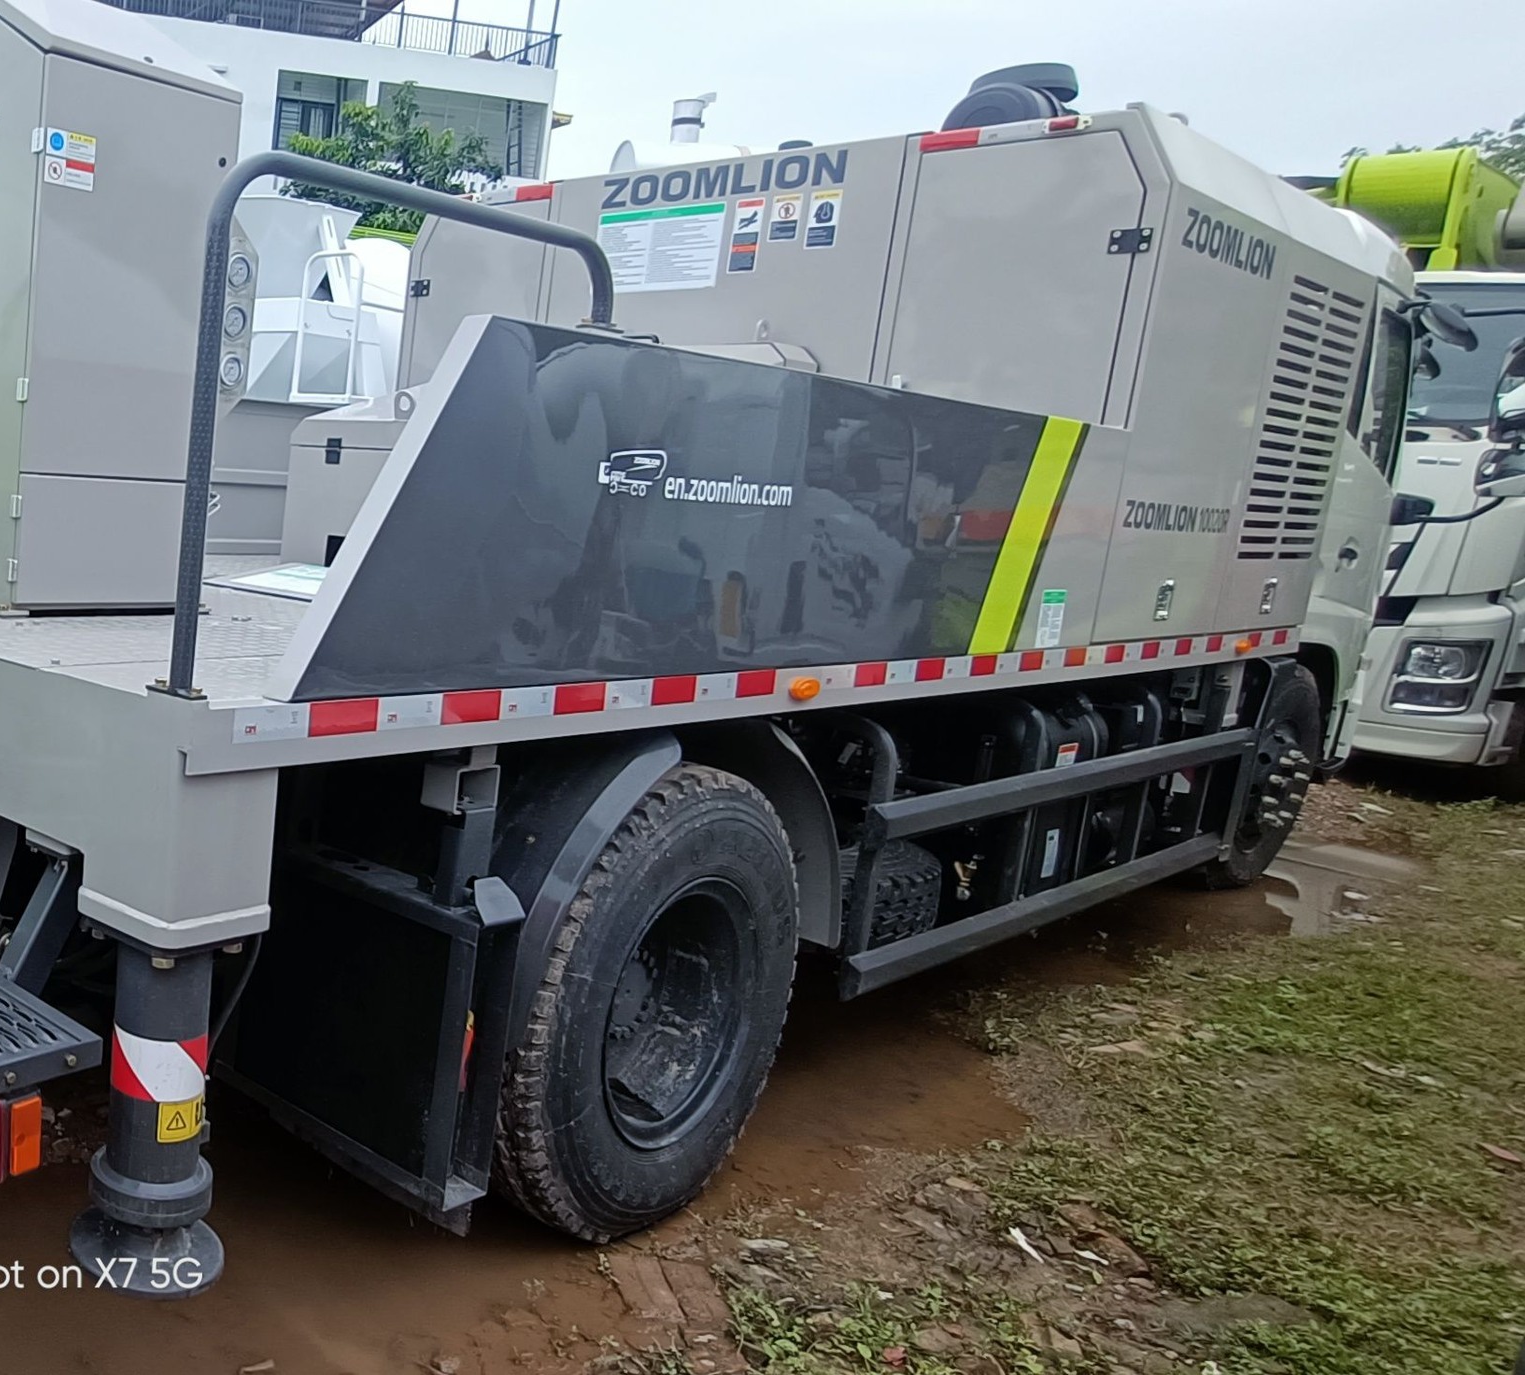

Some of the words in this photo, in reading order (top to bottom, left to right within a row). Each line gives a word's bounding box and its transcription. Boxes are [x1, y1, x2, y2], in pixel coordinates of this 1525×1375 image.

[601, 149, 848, 210] ZOOMLION
[1181, 207, 1277, 280] ZOOMLION
[664, 475, 793, 506] en.zoomlion.com
[1123, 500, 1198, 532] ZOOMLION
